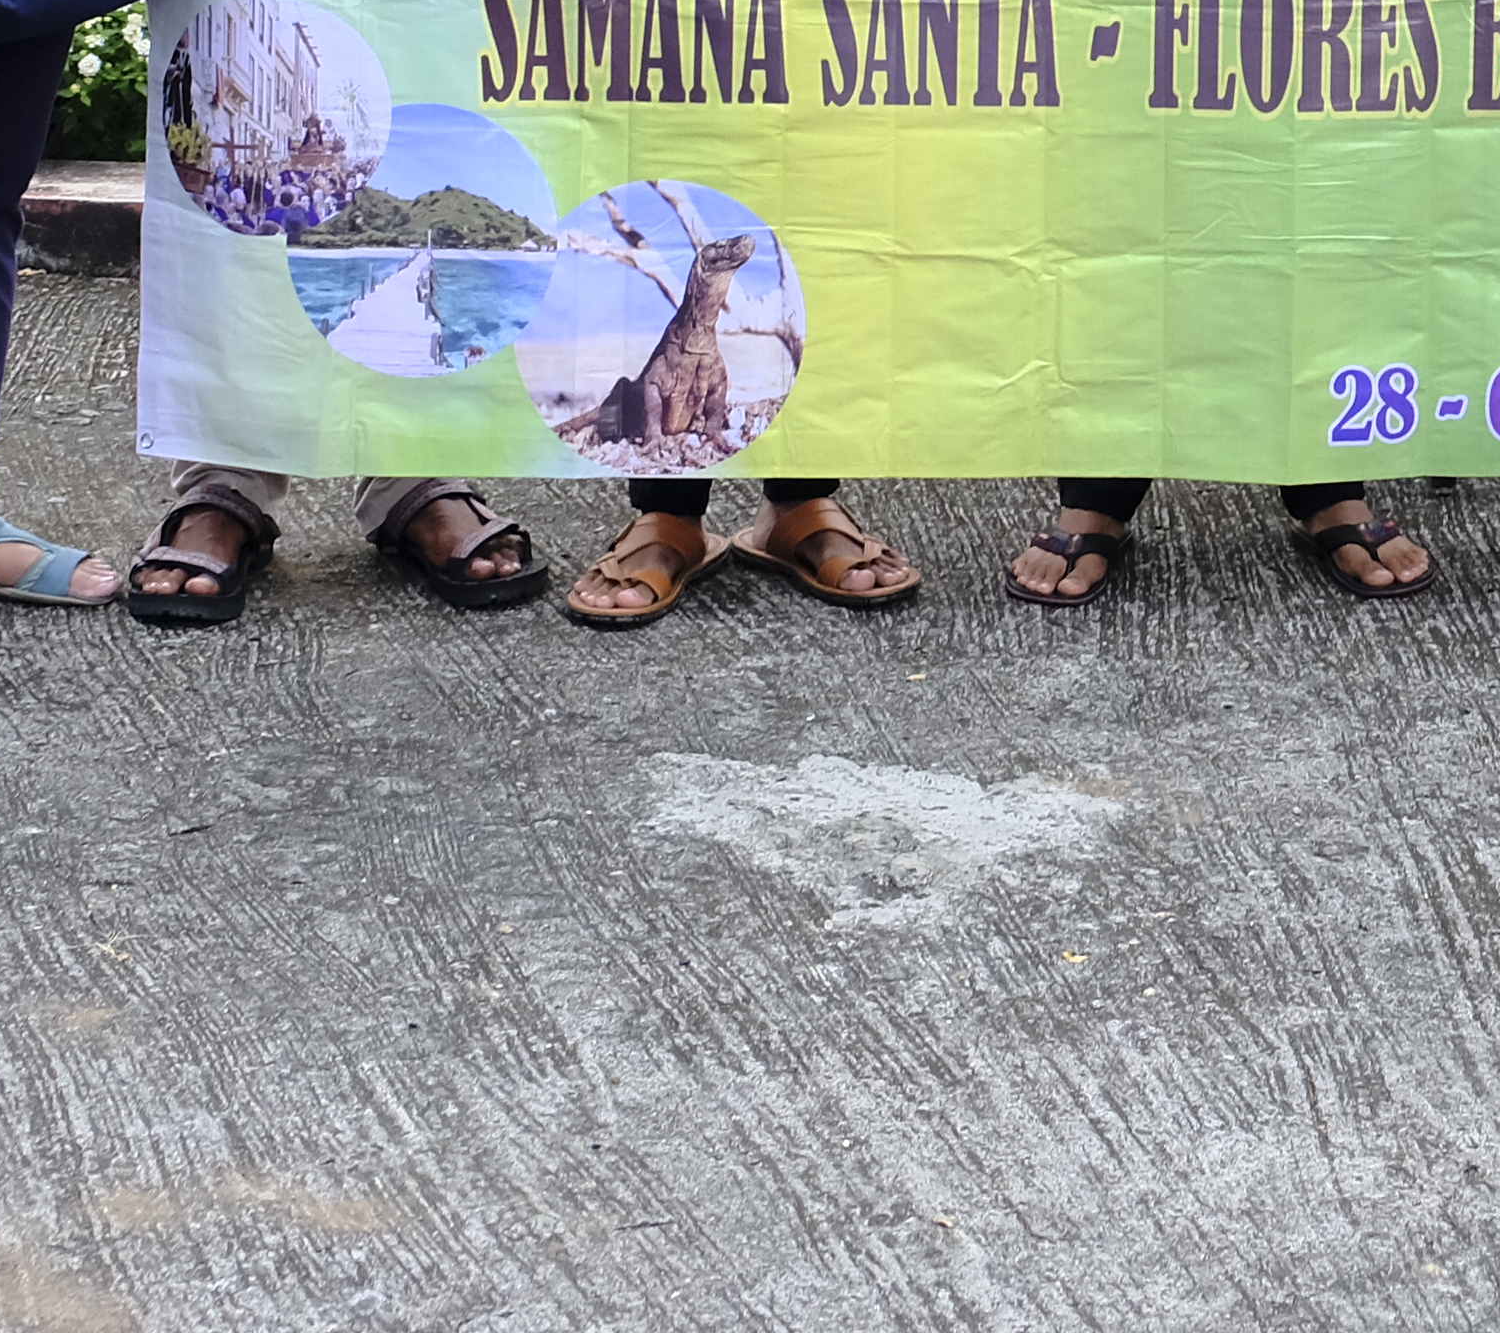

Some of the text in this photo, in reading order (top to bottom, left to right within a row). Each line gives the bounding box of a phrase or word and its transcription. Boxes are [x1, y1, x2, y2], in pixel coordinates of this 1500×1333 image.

[1090, 20, 1121, 62] -
[1329, 365, 1417, 443] 28
[1436, 396, 1467, 420] -
